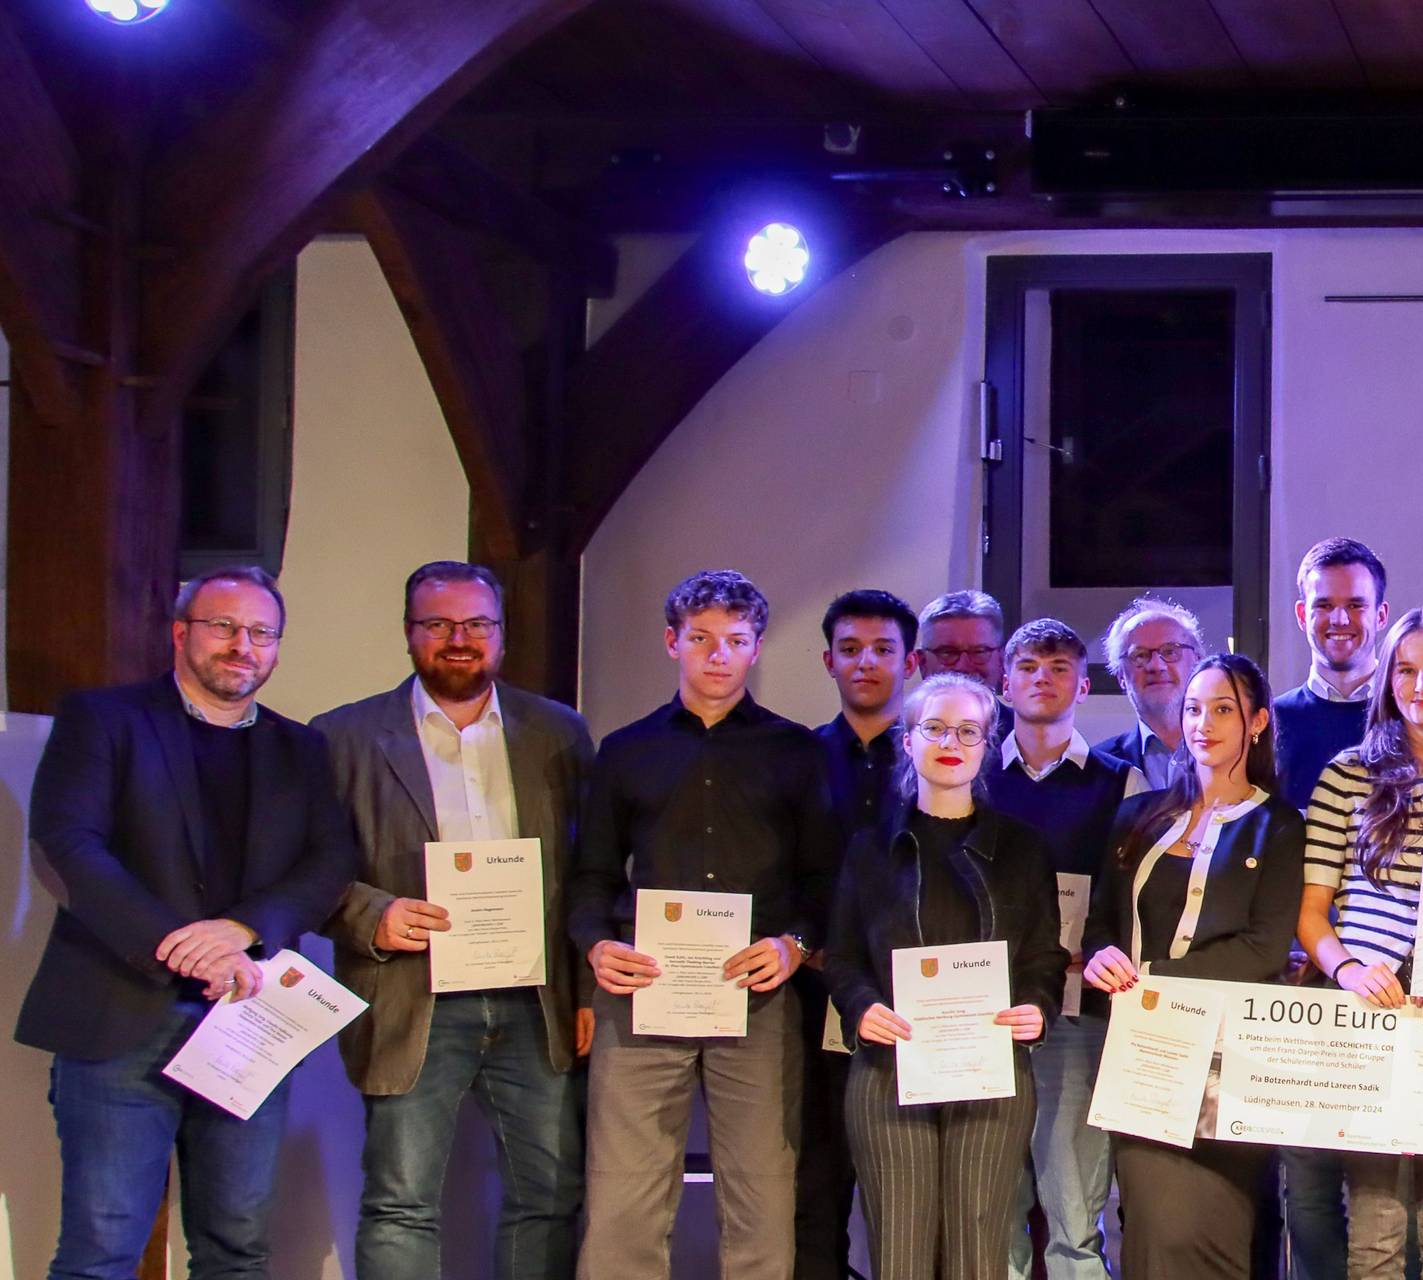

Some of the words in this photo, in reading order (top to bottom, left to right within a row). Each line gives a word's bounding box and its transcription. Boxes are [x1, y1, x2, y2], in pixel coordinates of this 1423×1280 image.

[486, 855, 524, 864] Urkunde
[696, 909, 734, 918] Urkunde
[952, 959, 991, 969] Urkunde
[308, 988, 340, 1014] Urkunde
[1170, 1001, 1206, 1016] Urkunde
[1243, 998, 1322, 1026] 1.000
[1334, 1004, 1397, 1031] Euro
[1246, 1034, 1263, 1042] Platz
[1250, 1075, 1262, 1083] Pia
[1264, 1076, 1312, 1087] Botzenhardt
[1314, 1080, 1329, 1088] und
[1331, 1082, 1356, 1090] Lareen
[1358, 1084, 1380, 1092] Sadik
[1244, 1095, 1302, 1108] Lüdinghausen,
[1304, 1100, 1316, 1108] 28.
[1318, 1102, 1360, 1112] November
[1362, 1105, 1382, 1113] 2024
